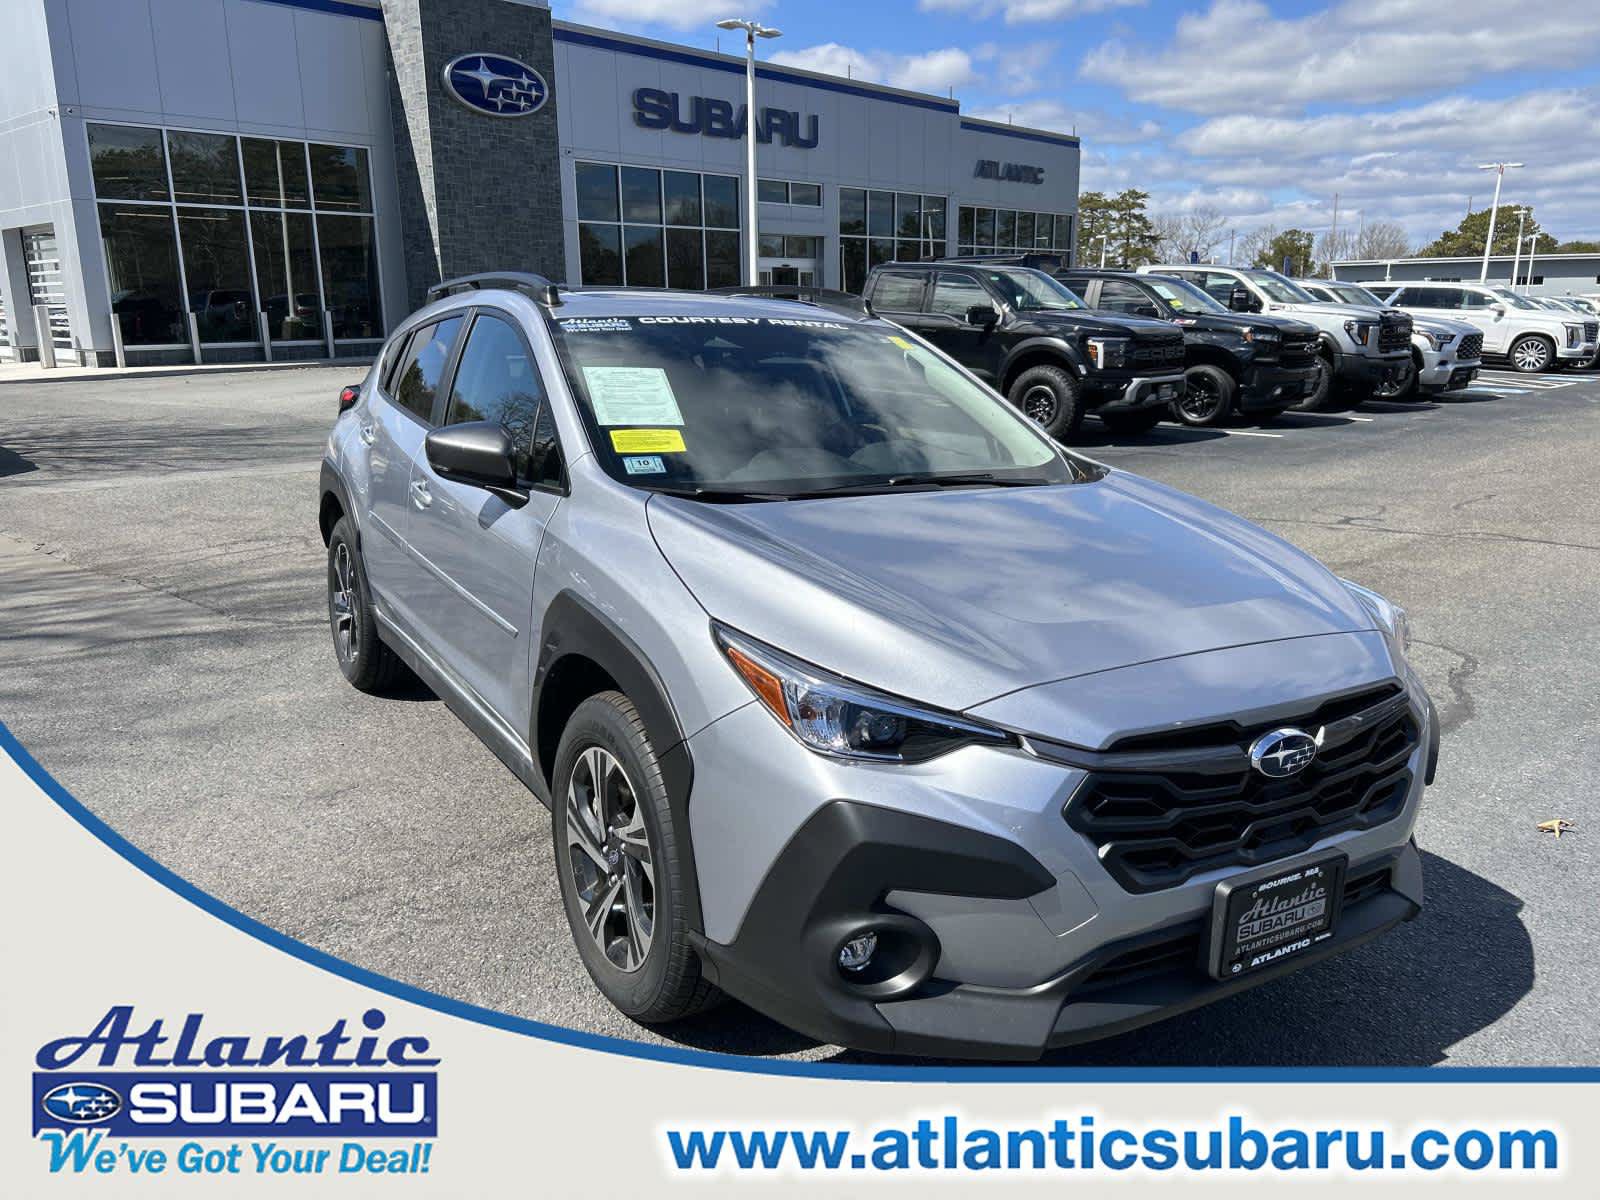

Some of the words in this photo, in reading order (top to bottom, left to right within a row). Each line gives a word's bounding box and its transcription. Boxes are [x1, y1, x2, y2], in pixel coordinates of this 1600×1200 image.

[633, 87, 819, 149] SUBARU
[974, 159, 1045, 185] ATLANTIC
[768, 318, 849, 330] RENTAL
[1239, 882, 1326, 923] Atlantic
[1240, 906, 1306, 942] SUBARU
[1251, 939, 1310, 967] ATLANTIC
